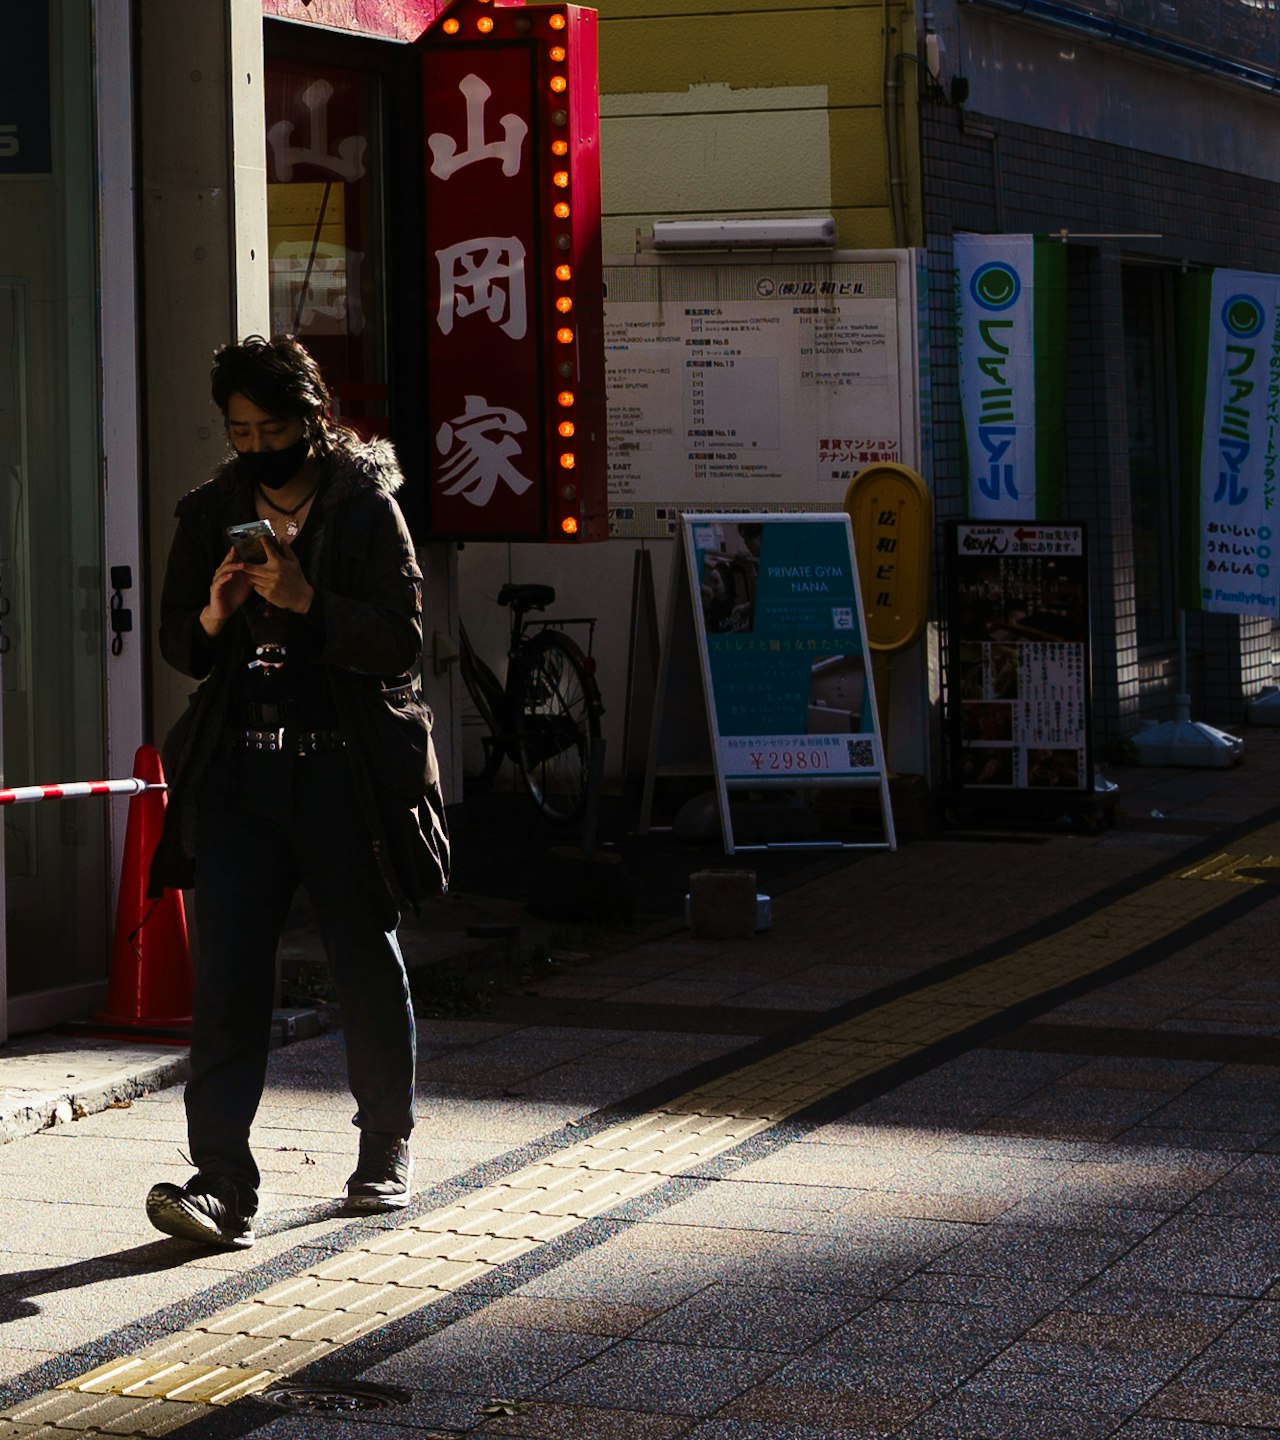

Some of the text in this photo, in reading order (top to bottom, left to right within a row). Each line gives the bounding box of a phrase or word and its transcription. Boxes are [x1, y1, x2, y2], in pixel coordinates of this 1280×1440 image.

[426, 72, 535, 508] 山岡家
[1213, 344, 1256, 506] ファミマル
[715, 452, 737, 460] No.20
[1207, 522, 1256, 537] おいしい
[1207, 540, 1256, 557] うれしい
[876, 509, 897, 608] 広和ビル
[1206, 558, 1255, 577] あんしん
[767, 566, 843, 578] PRIVATE GYM
[791, 581, 829, 593] NANA
[1215, 588, 1277, 606] FamilyMart
[749, 750, 830, 770] ¥2980!
